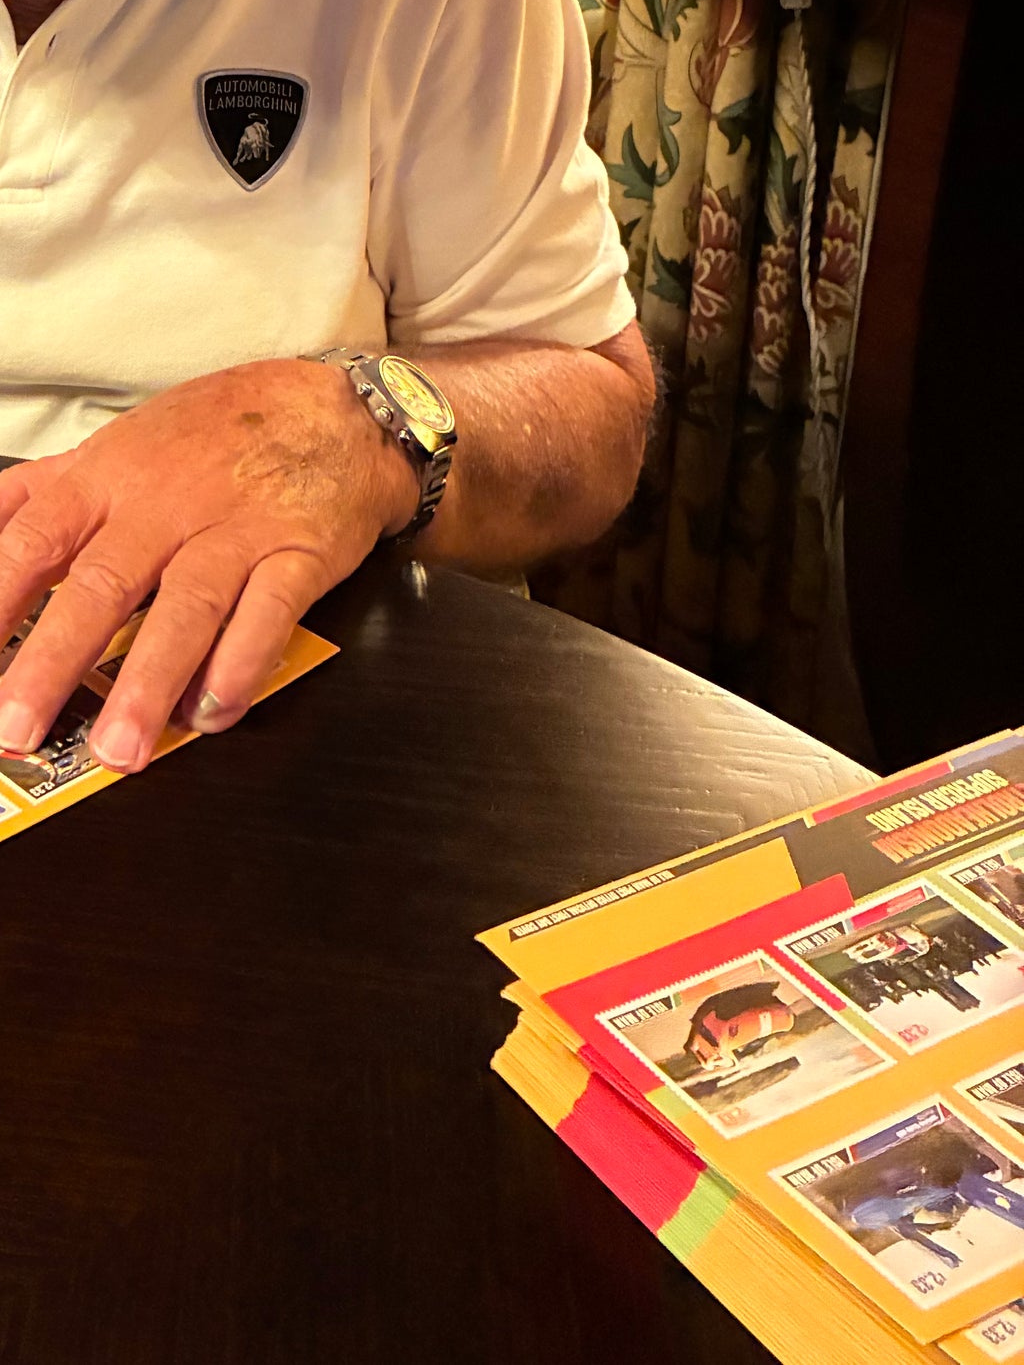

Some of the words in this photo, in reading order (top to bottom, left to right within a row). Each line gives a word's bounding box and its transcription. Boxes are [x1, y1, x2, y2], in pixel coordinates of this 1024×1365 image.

[215, 80, 292, 98] AUTOMOBILI
[208, 95, 297, 115] LAMBORGHINI
[918, 768, 1009, 812] SUPERCAR
[865, 797, 936, 833] ISLAND
[809, 933, 826, 946] OF
[818, 926, 842, 942] ISLE
[787, 938, 816, 955] MAN
[634, 1007, 651, 1021] OF
[645, 1000, 668, 1016] ISLE
[612, 1012, 638, 1030] MAN
[970, 1082, 1000, 1100] MAN
[991, 1077, 1009, 1091] OF
[812, 1163, 829, 1177] OF
[823, 1154, 844, 1170] ISLE
[786, 1167, 816, 1188] MAN
